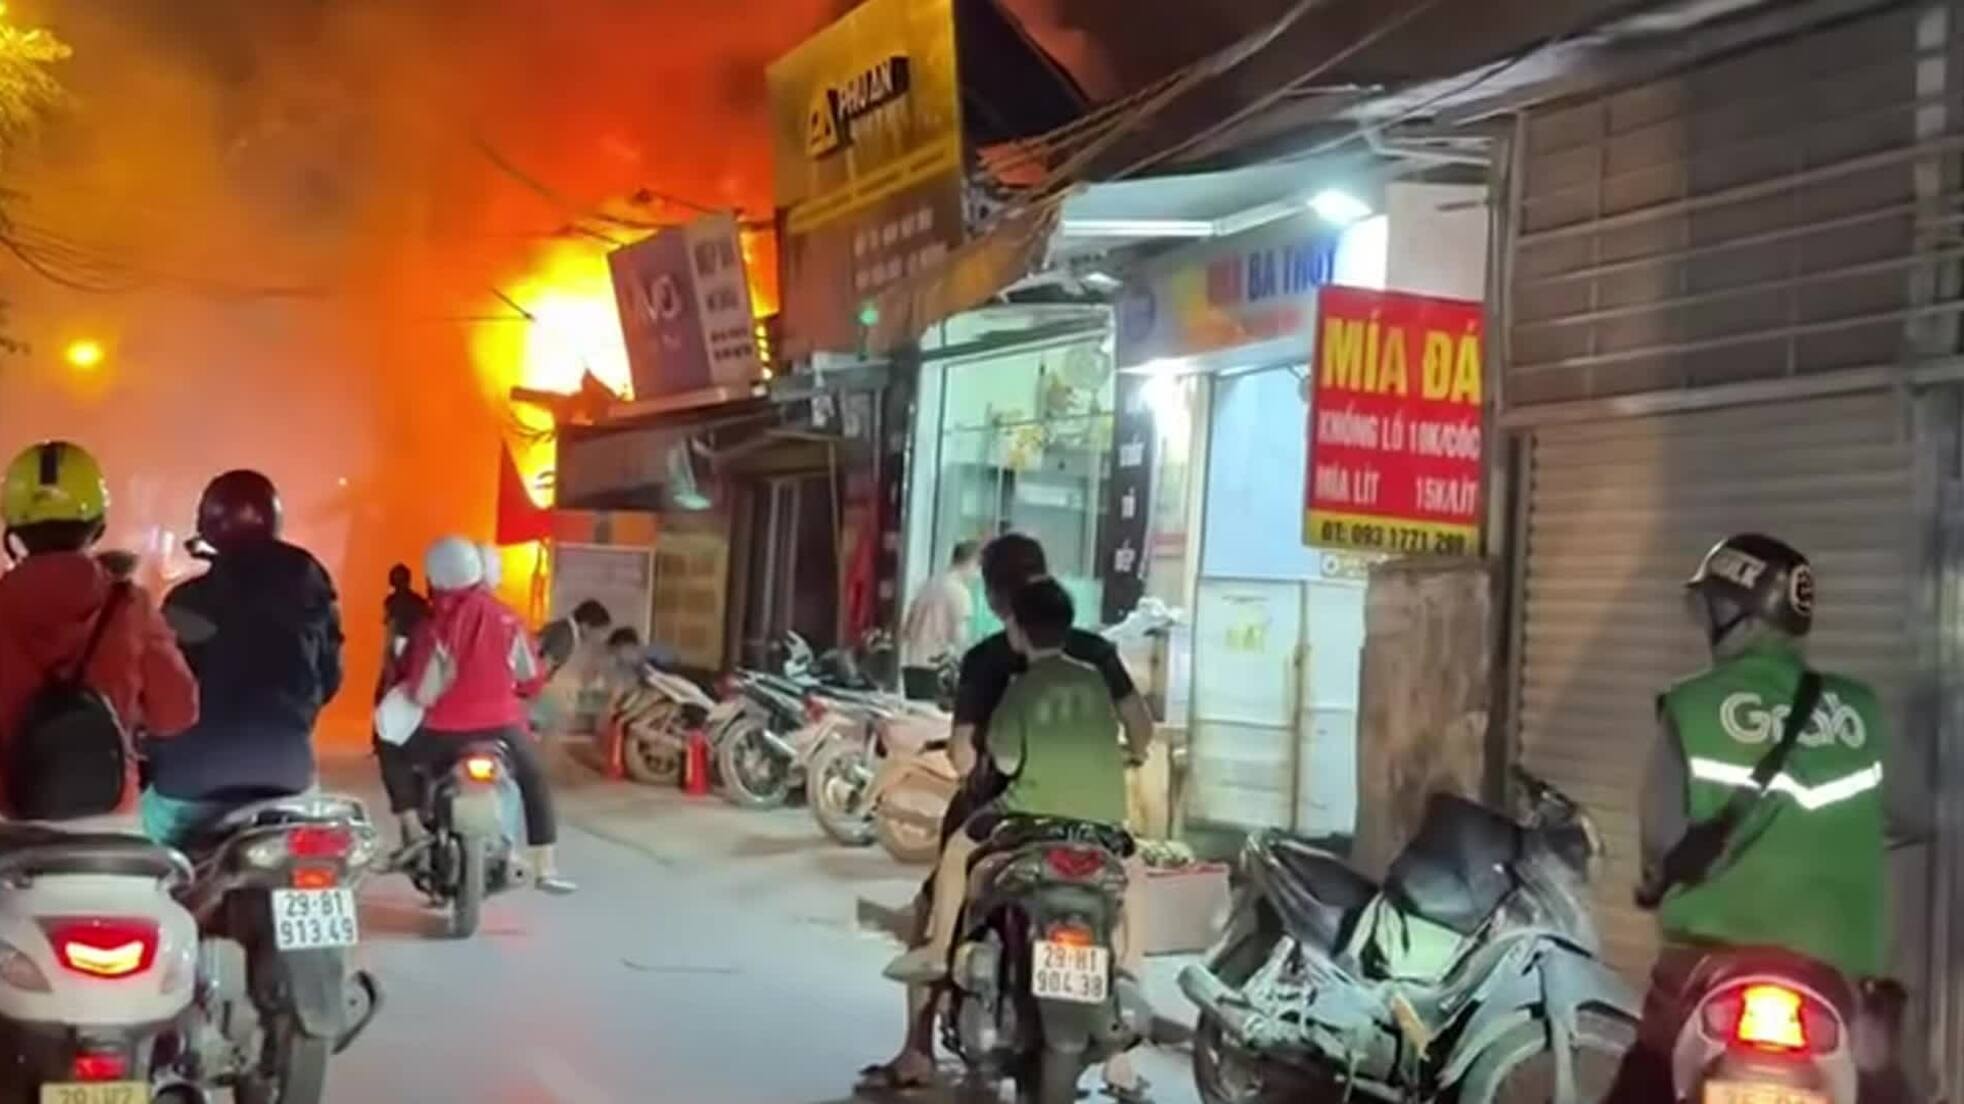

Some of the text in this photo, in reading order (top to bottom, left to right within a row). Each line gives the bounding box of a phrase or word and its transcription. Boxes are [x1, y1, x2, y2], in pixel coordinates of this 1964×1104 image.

[1322, 309, 1482, 405] MÍA ĐÁ
[1354, 464, 1380, 505] LÍT
[1719, 692, 1866, 749] Grab
